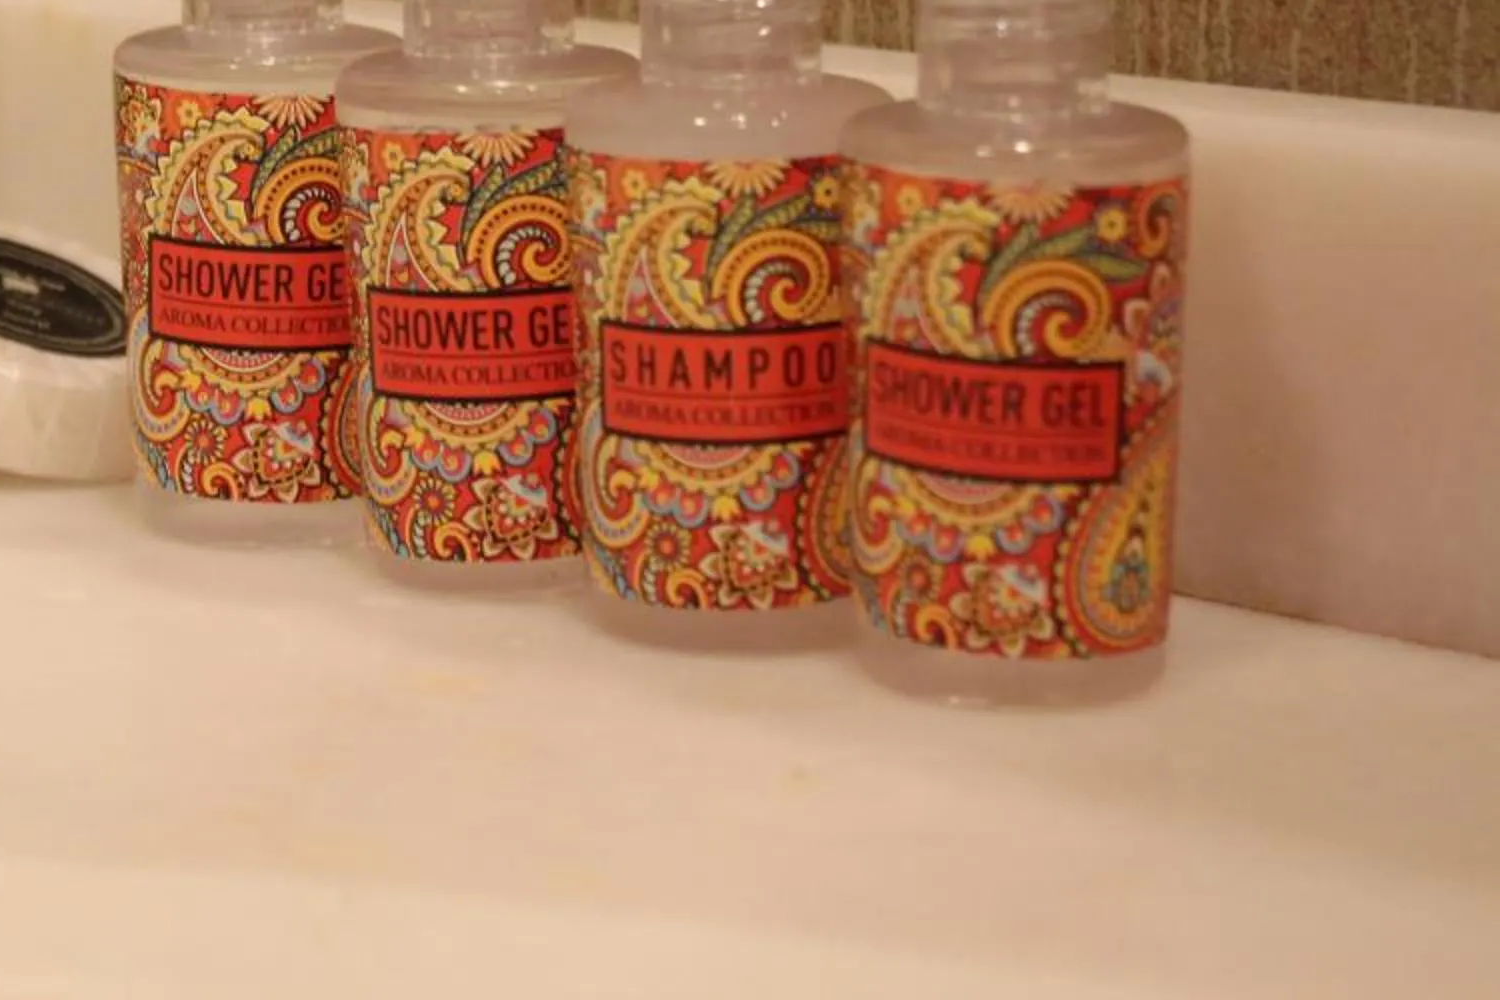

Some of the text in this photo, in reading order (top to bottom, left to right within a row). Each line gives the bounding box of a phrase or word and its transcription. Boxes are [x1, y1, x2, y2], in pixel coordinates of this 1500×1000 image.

[158, 252, 346, 304] SHOWER GE
[160, 305, 226, 332] AROMA
[376, 303, 571, 351] SHOWER GE
[383, 357, 580, 386] AROMA COLLECTIO
[609, 339, 838, 392] SHAMPOO
[872, 360, 1108, 429] SHOWER GEL
